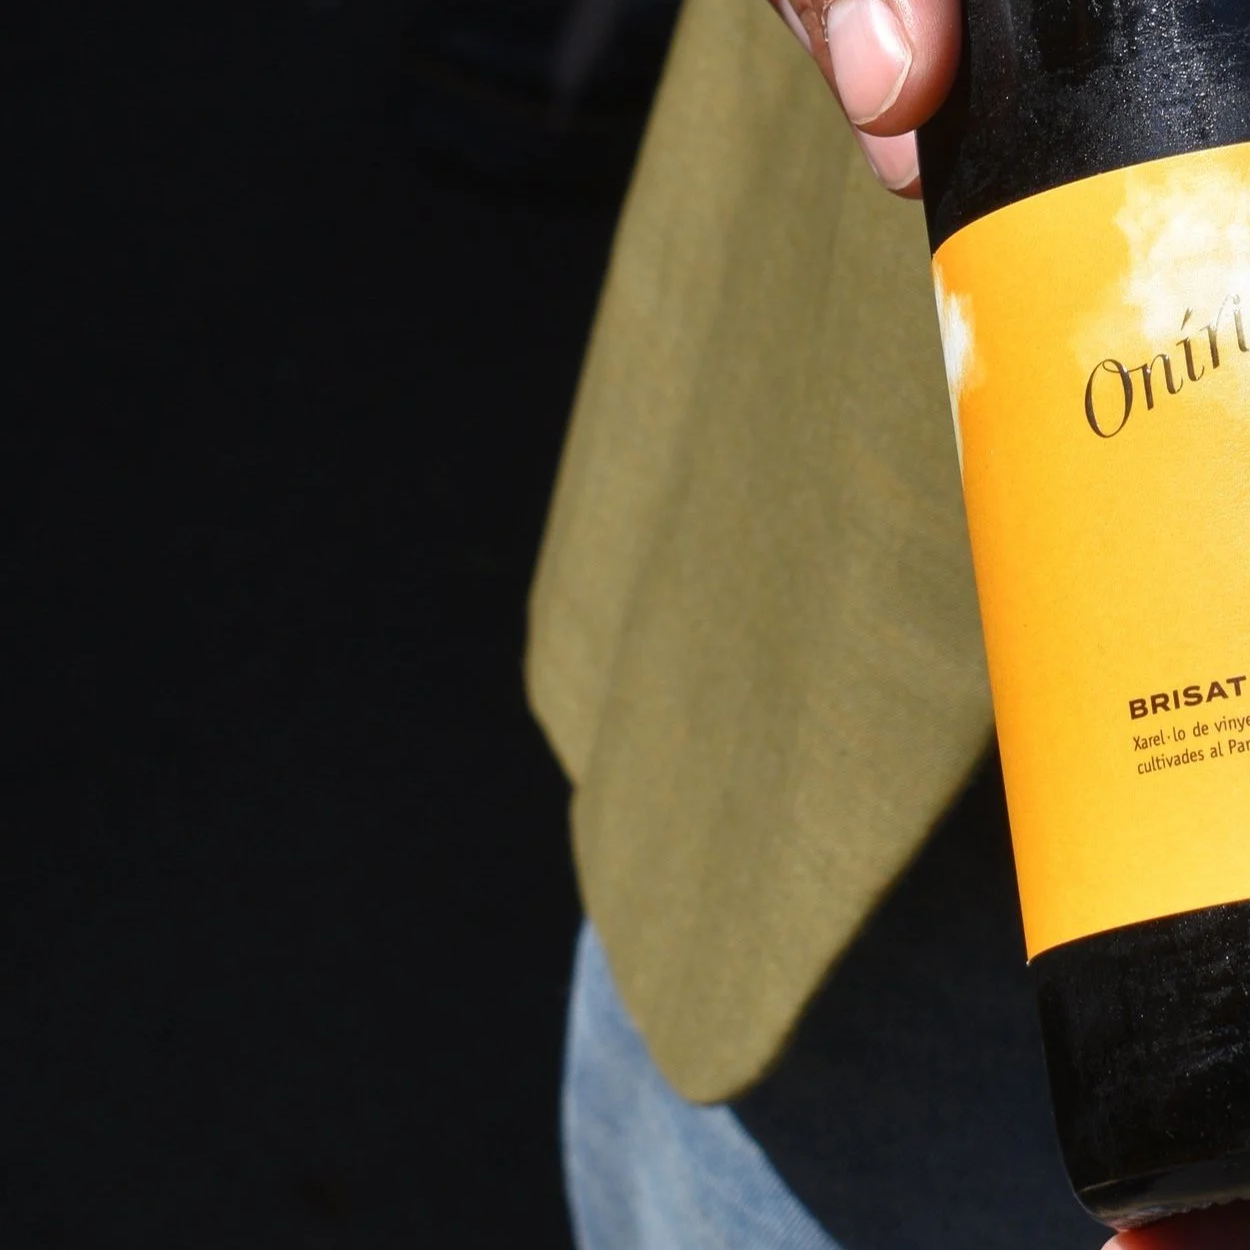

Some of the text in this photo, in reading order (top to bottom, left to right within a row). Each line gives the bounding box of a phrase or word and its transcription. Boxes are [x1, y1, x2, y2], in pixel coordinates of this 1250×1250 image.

[1129, 675, 1247, 720] BRISAT
[1193, 721, 1209, 738] de
[1137, 747, 1205, 775] cultivades
[1210, 742, 1223, 759] al
